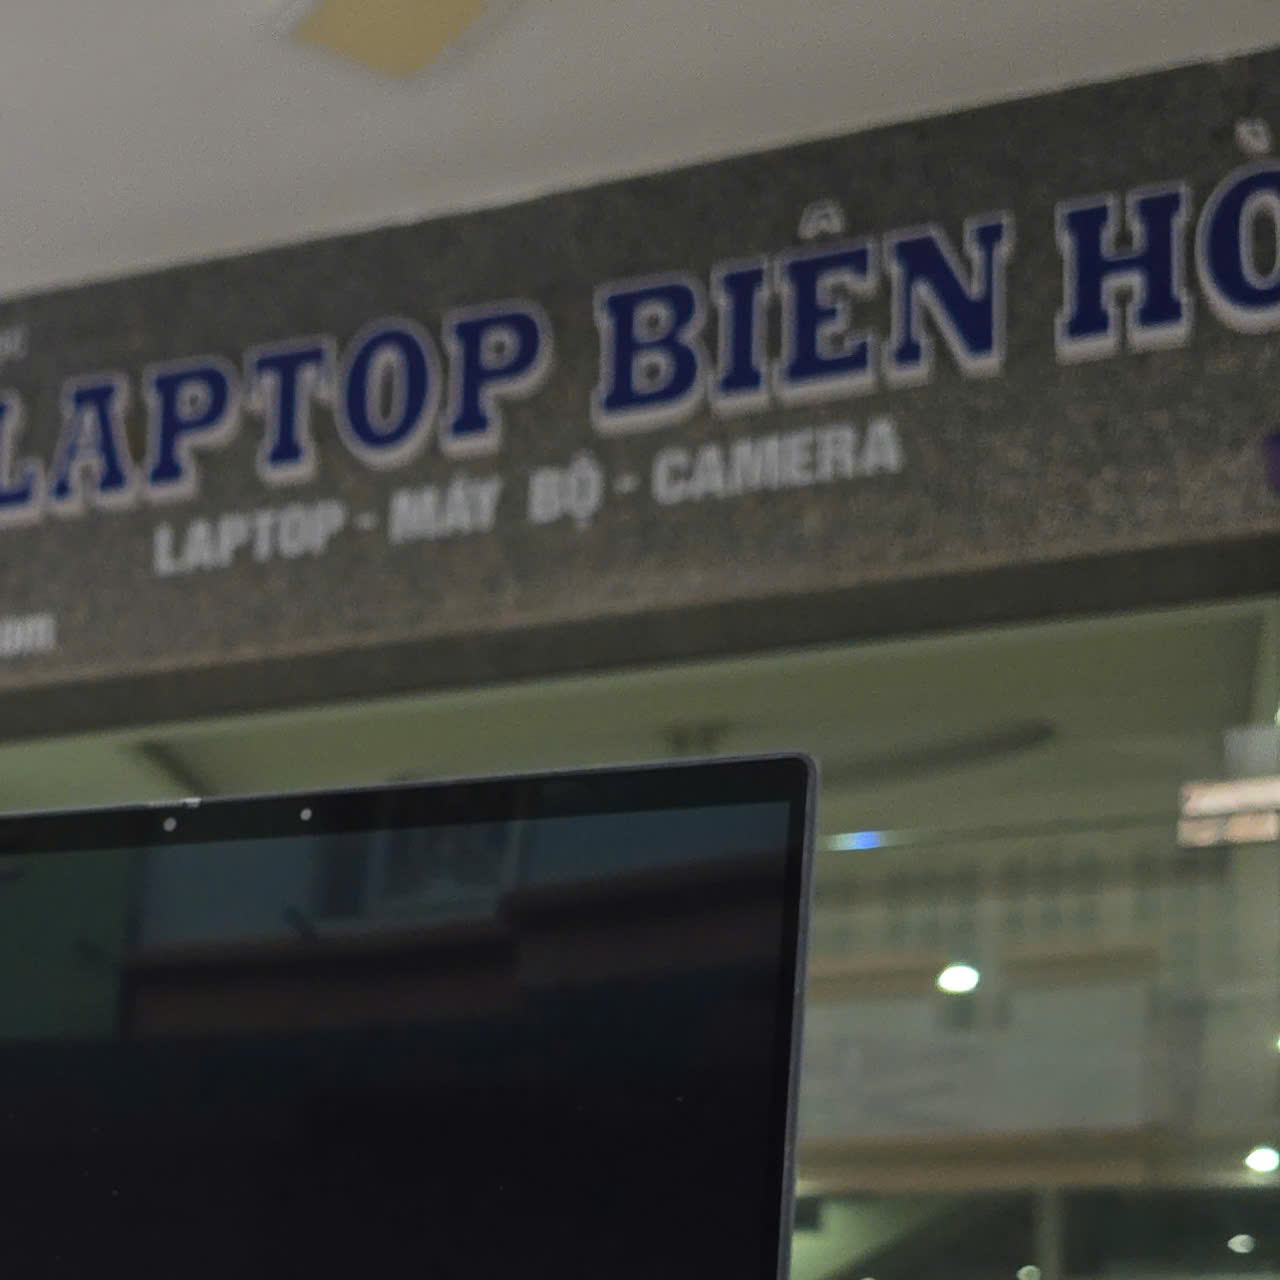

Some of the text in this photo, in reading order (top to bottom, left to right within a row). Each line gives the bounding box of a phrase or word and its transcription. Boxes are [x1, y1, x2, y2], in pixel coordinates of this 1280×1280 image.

[592, 203, 1014, 434] BIÊN
[154, 501, 346, 576] LAPTOP
[387, 472, 500, 545] MÁY
[527, 451, 602, 529] BỘ
[652, 416, 905, 504] CAMERA
